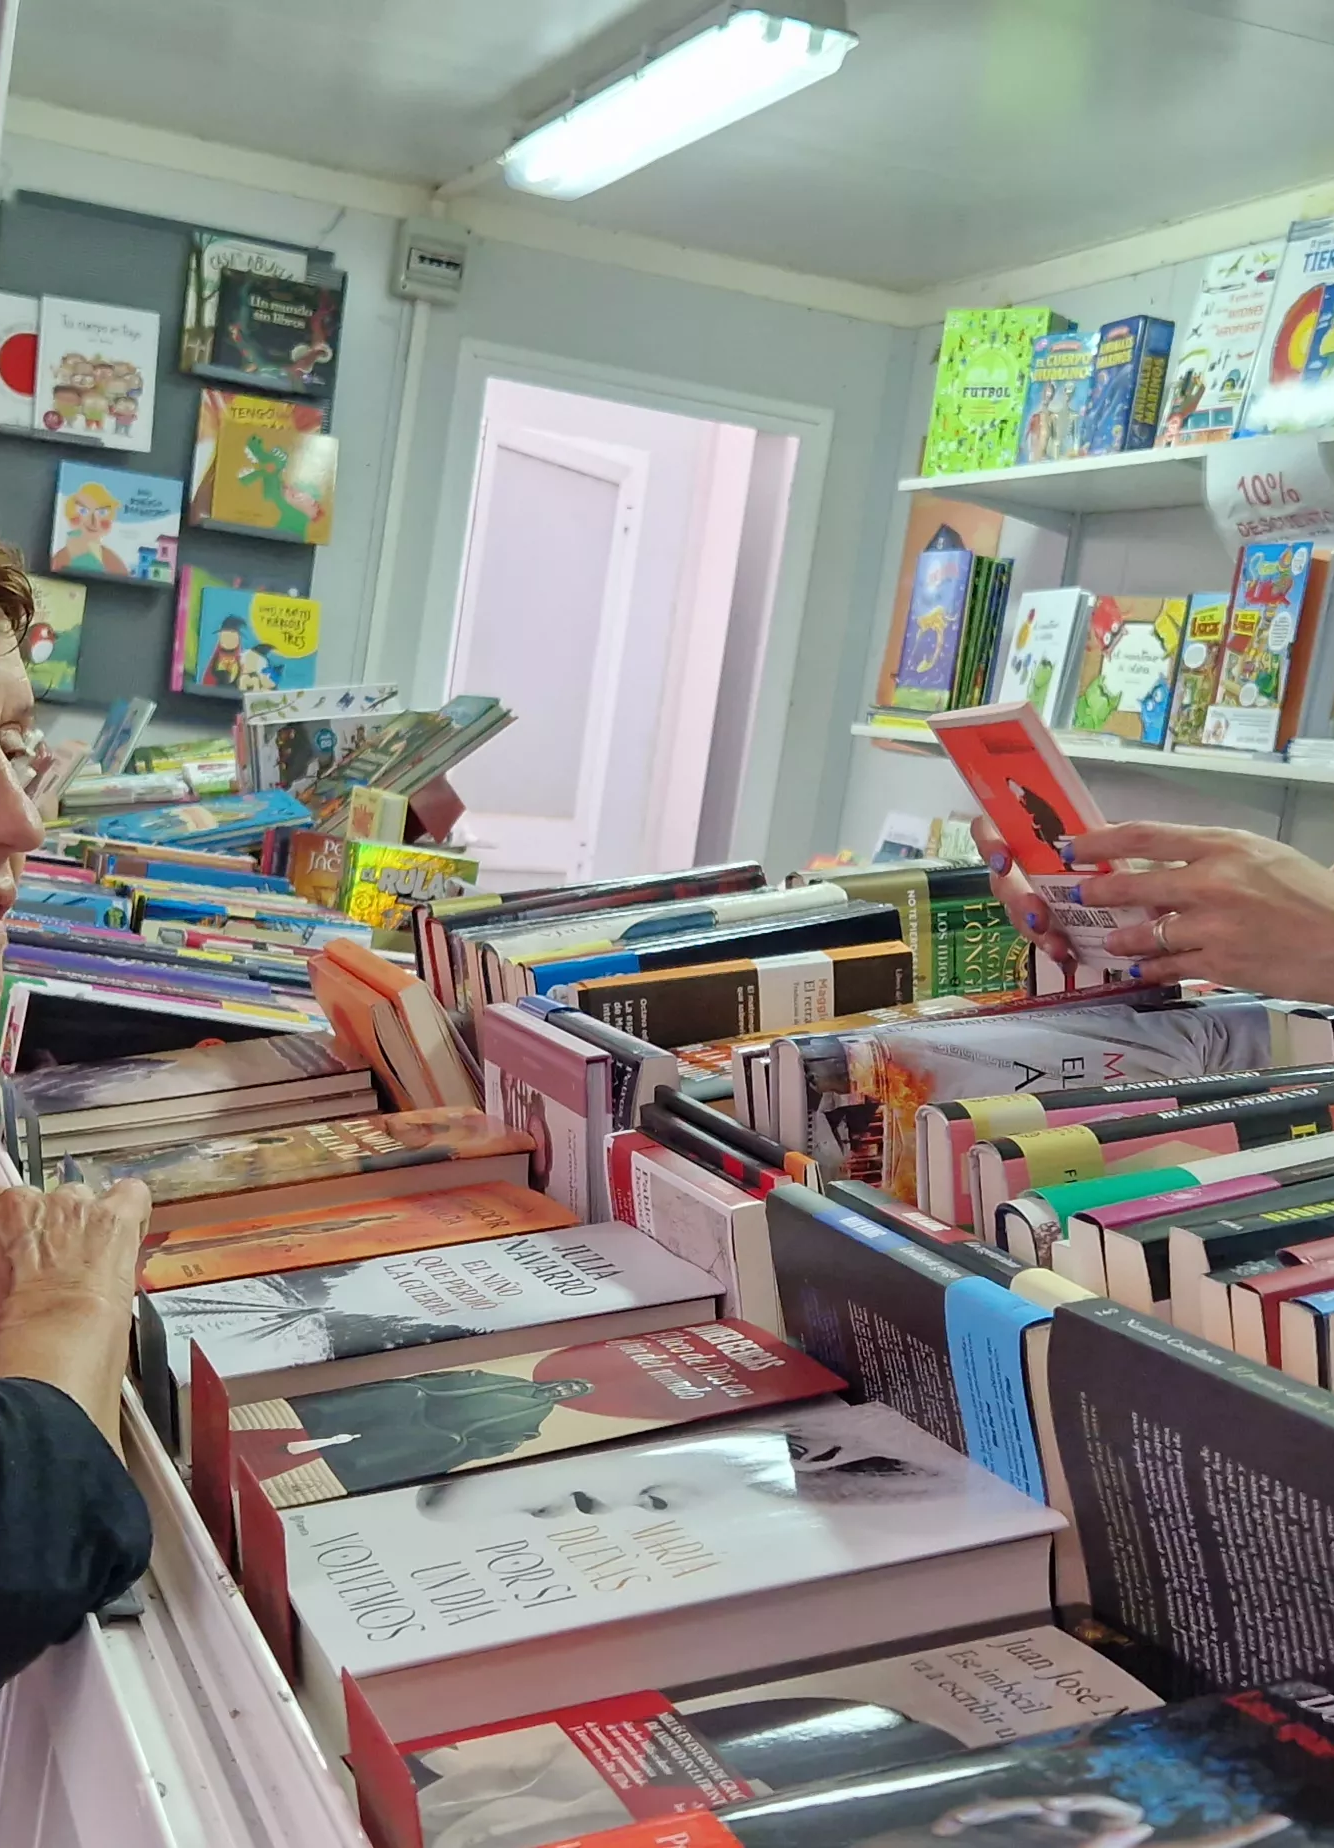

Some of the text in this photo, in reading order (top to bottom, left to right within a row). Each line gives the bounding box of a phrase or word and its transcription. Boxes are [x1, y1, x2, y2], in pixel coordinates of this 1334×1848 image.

[269, 299, 314, 318] mundo
[273, 313, 306, 330] libros
[1031, 366, 1092, 382] HUMANO
[1046, 353, 1094, 367] CUERPO
[230, 406, 276, 420] TENGO
[1237, 471, 1301, 510] 10%
[281, 630, 307, 650] TRES
[377, 867, 447, 899] RULA
[906, 889, 916, 911] NO
[907, 911, 917, 923] TE
[935, 911, 950, 985] LOS HIJOS
[986, 901, 1002, 981] LA SAGA
[804, 980, 816, 997] El
[625, 999, 635, 1013] La
[1013, 1060, 1048, 1092] A
[1101, 1070, 1262, 1094] BEATRIZ SERRANO
[1102, 1052, 1127, 1081] M
[1156, 1086, 1320, 1121] BEATRIZ SERRANO
[461, 1258, 524, 1298] EL NIÑO
[496, 1238, 599, 1298] NAVARRO
[551, 1242, 626, 1282] JULIA
[383, 1261, 460, 1318] LA GUERRA
[412, 1255, 506, 1312] QUE PERDIÓ
[629, 1352, 678, 1371] del
[678, 1352, 718, 1367] de
[691, 1362, 741, 1386] Dios
[647, 1367, 714, 1401] mundo
[719, 1383, 755, 1398] en
[546, 1524, 653, 1594] DUEÑAS
[630, 1519, 729, 1580] MARÍA
[310, 1531, 427, 1643] VOLVEMOS
[475, 1539, 579, 1610] POR SI
[410, 1560, 508, 1627] UN DÍA
[945, 1649, 1055, 1716] Ese imbécil
[985, 1637, 1115, 1706] Juan José
[910, 1657, 934, 1674] va
[937, 1680, 1006, 1727] escribir
